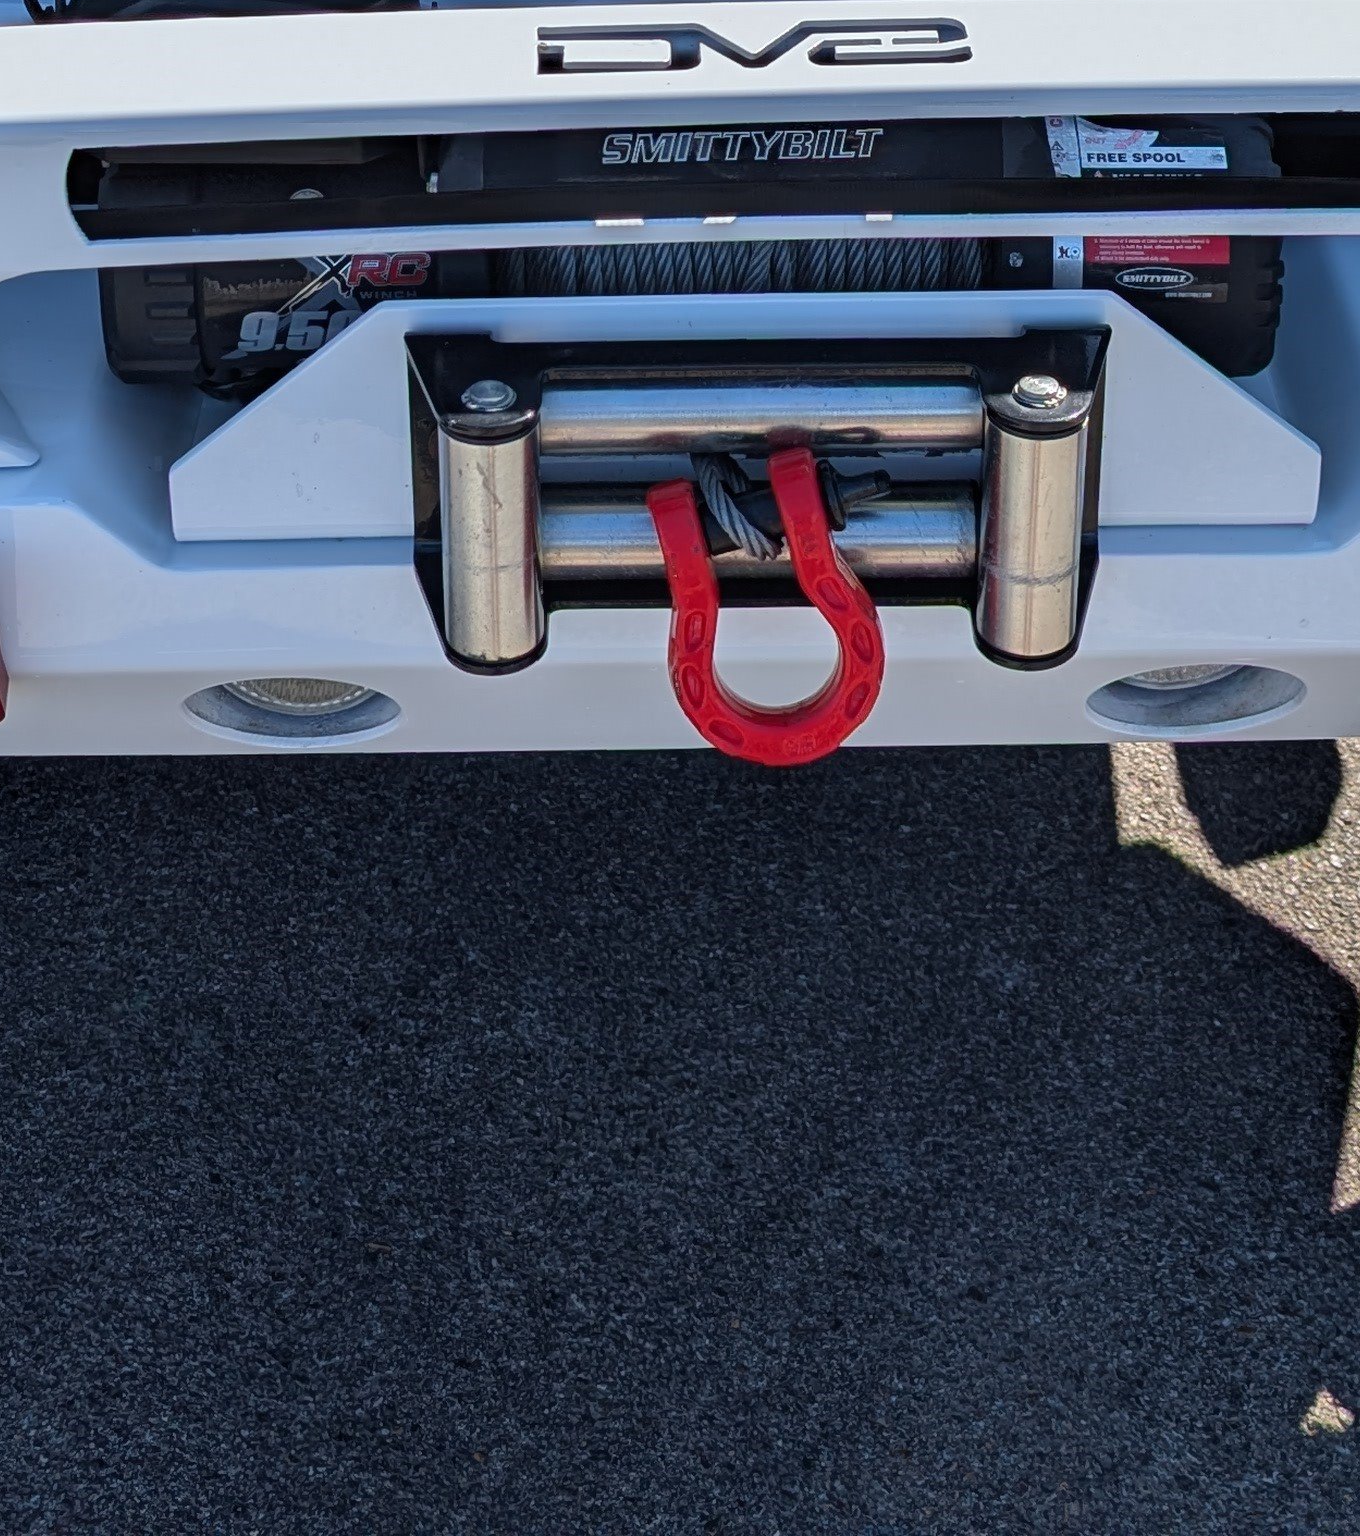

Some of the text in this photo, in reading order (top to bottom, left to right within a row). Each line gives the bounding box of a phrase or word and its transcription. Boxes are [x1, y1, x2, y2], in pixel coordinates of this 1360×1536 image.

[537, 17, 974, 76] DV8
[602, 128, 884, 164] SMITTYBILT
[1087, 152, 1186, 163] FREE SPOOL
[1122, 274, 1188, 283] SMITTYBILT
[359, 290, 418, 300] WINCH
